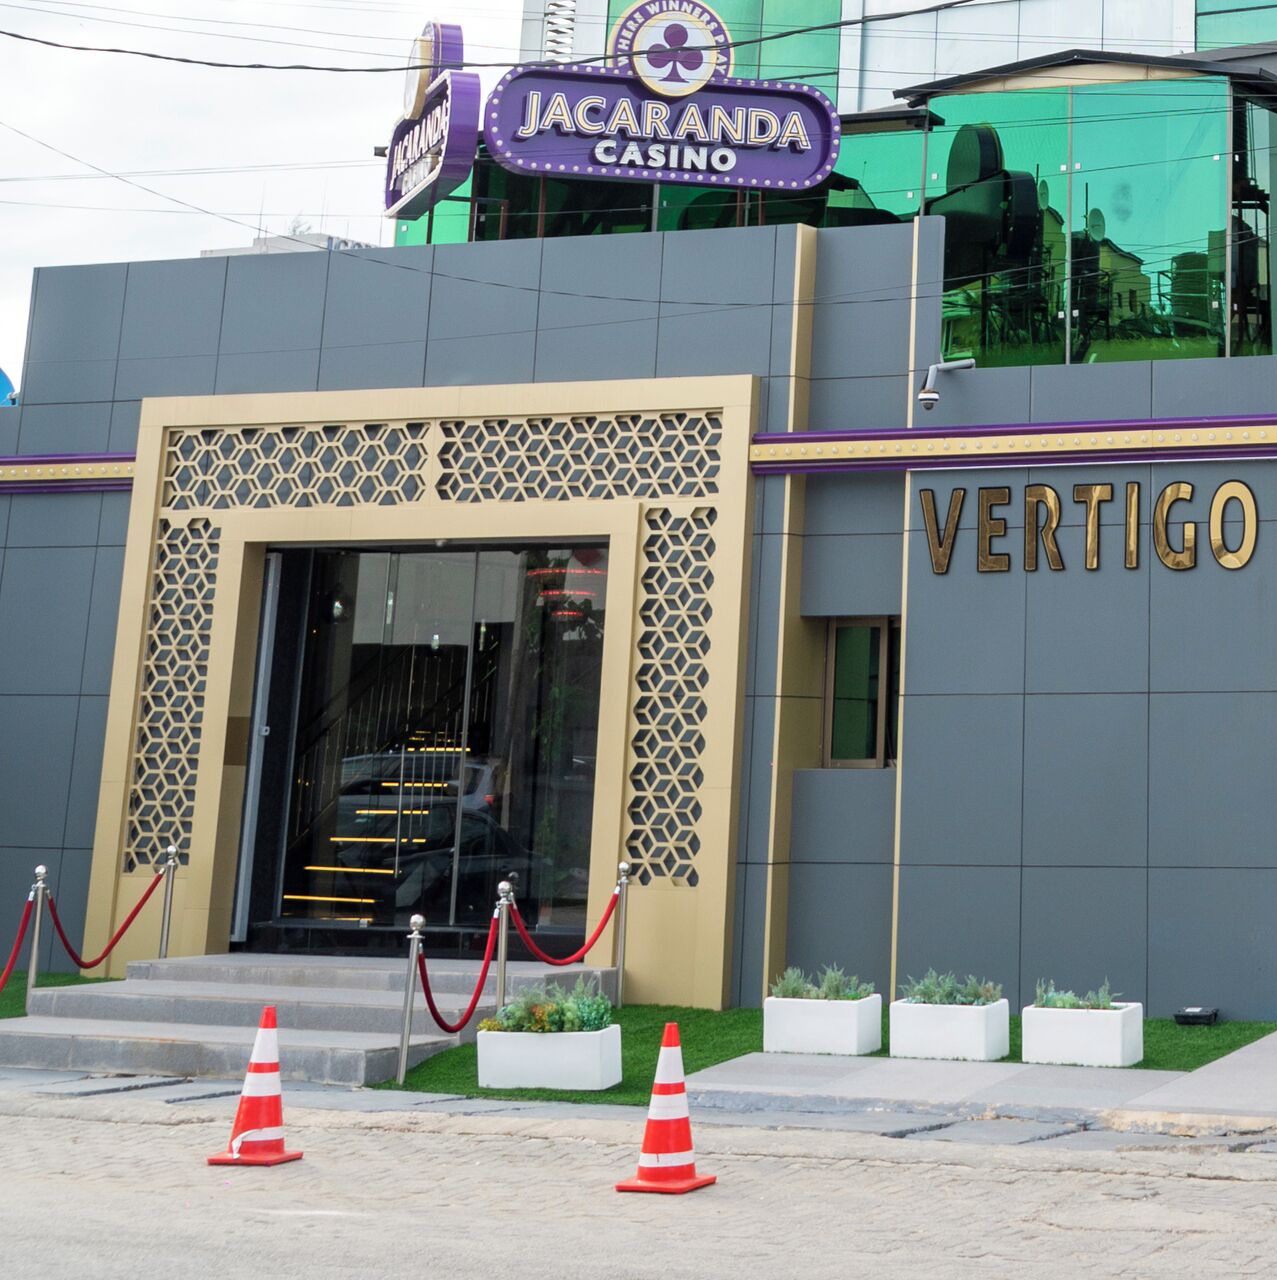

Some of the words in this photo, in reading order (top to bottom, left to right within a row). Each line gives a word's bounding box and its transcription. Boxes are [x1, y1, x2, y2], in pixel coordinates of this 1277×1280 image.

[617, 11, 645, 67] WHERE
[645, 0, 718, 32] WINNERS
[518, 90, 812, 149] JACARANDA
[592, 140, 737, 172] CASINO
[918, 478, 1259, 576] VERTIGO
